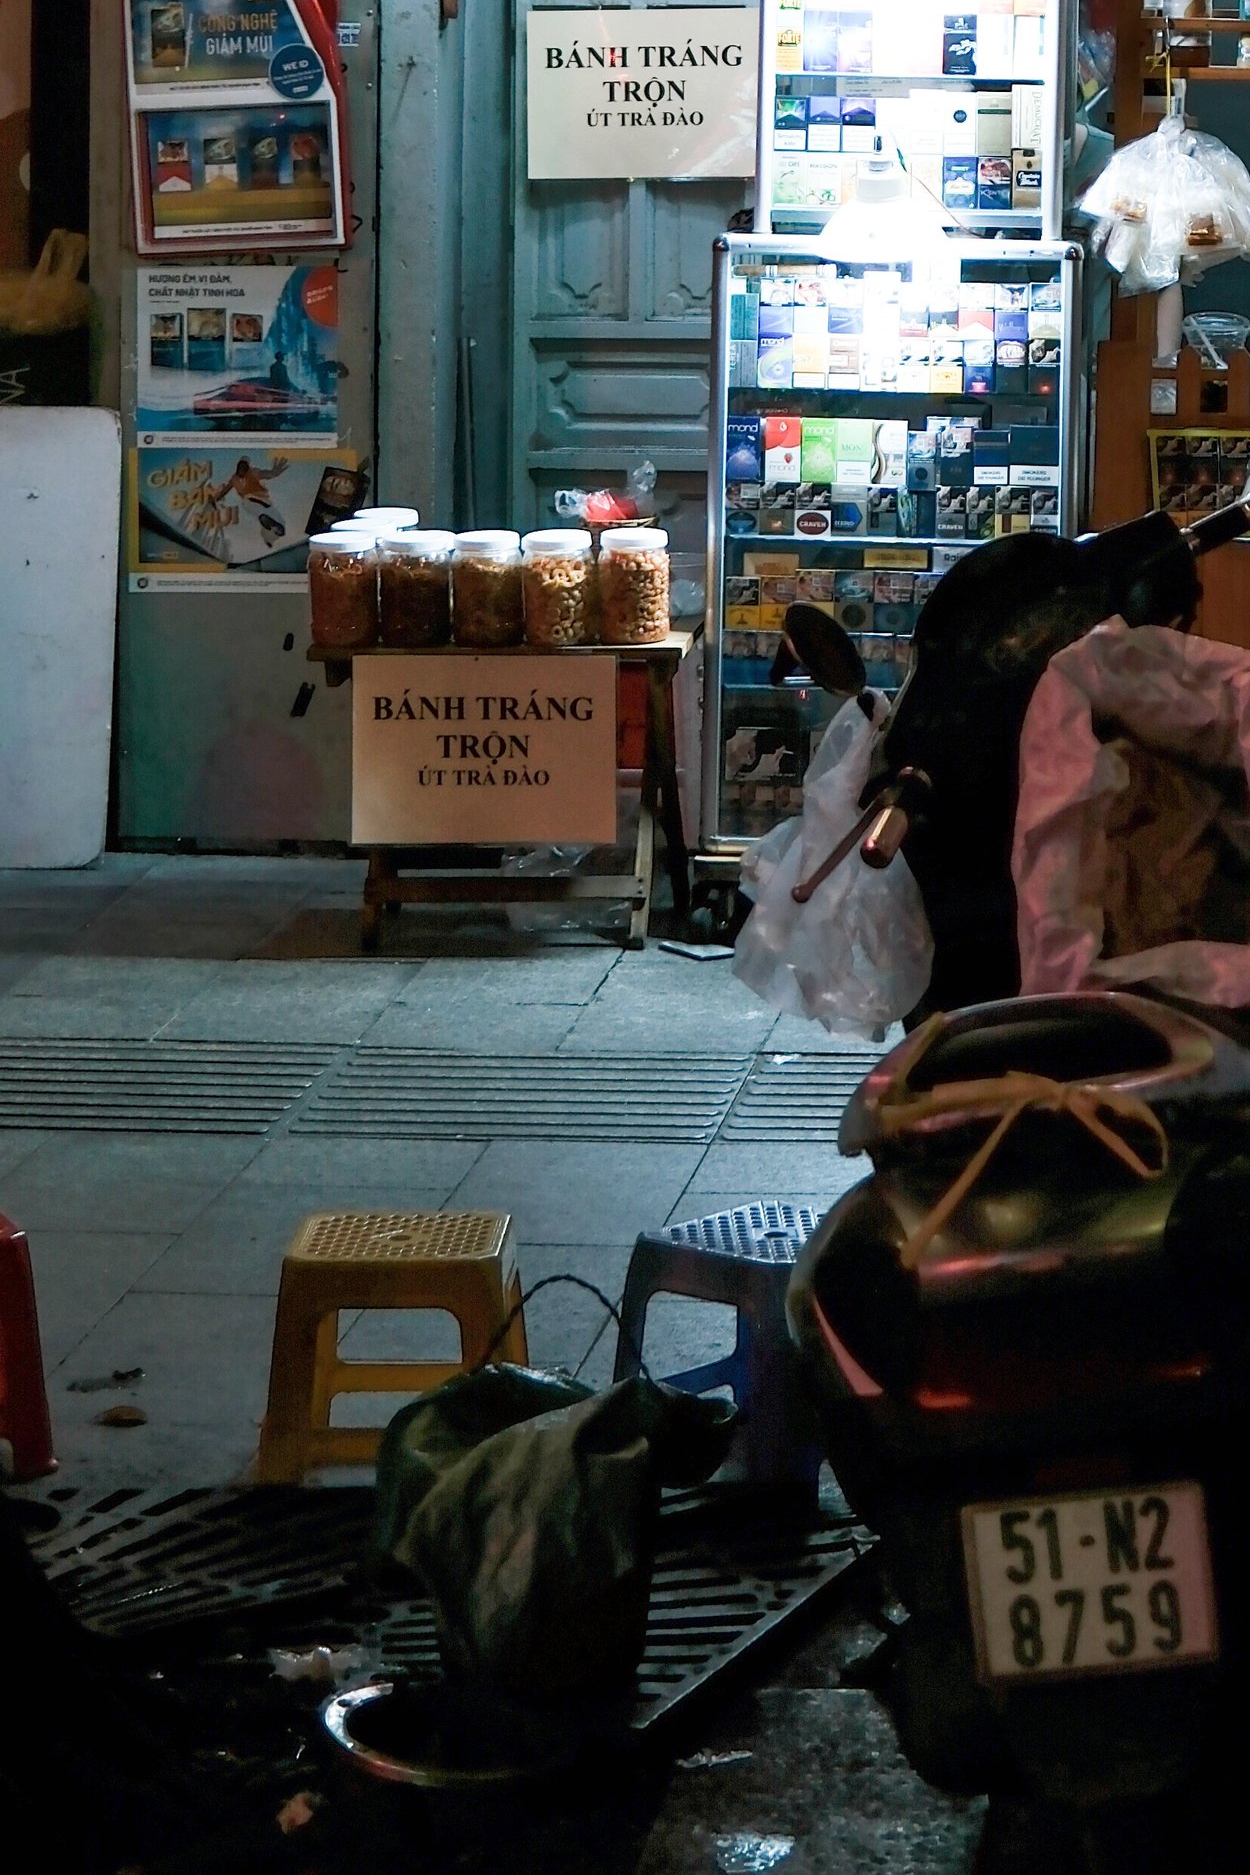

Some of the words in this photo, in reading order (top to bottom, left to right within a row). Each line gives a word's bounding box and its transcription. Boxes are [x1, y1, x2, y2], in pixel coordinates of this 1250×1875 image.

[544, 40, 630, 69] BÁNH
[637, 39, 743, 68] TRÁNG
[602, 77, 687, 108] TRỘN
[586, 108, 612, 128] ÚT
[617, 108, 657, 127] TRÀ
[662, 108, 705, 127] ĐÀO
[937, 523, 964, 531] CRAVEN
[372, 689, 466, 722] BÁNH
[475, 689, 594, 722] TRÁNG
[435, 730, 530, 766] TRỘN
[417, 766, 449, 788] ÚT
[452, 766, 496, 787] TRÀ
[503, 766, 551, 787] ĐÀO
[1008, 1579, 1184, 1669] 8759
